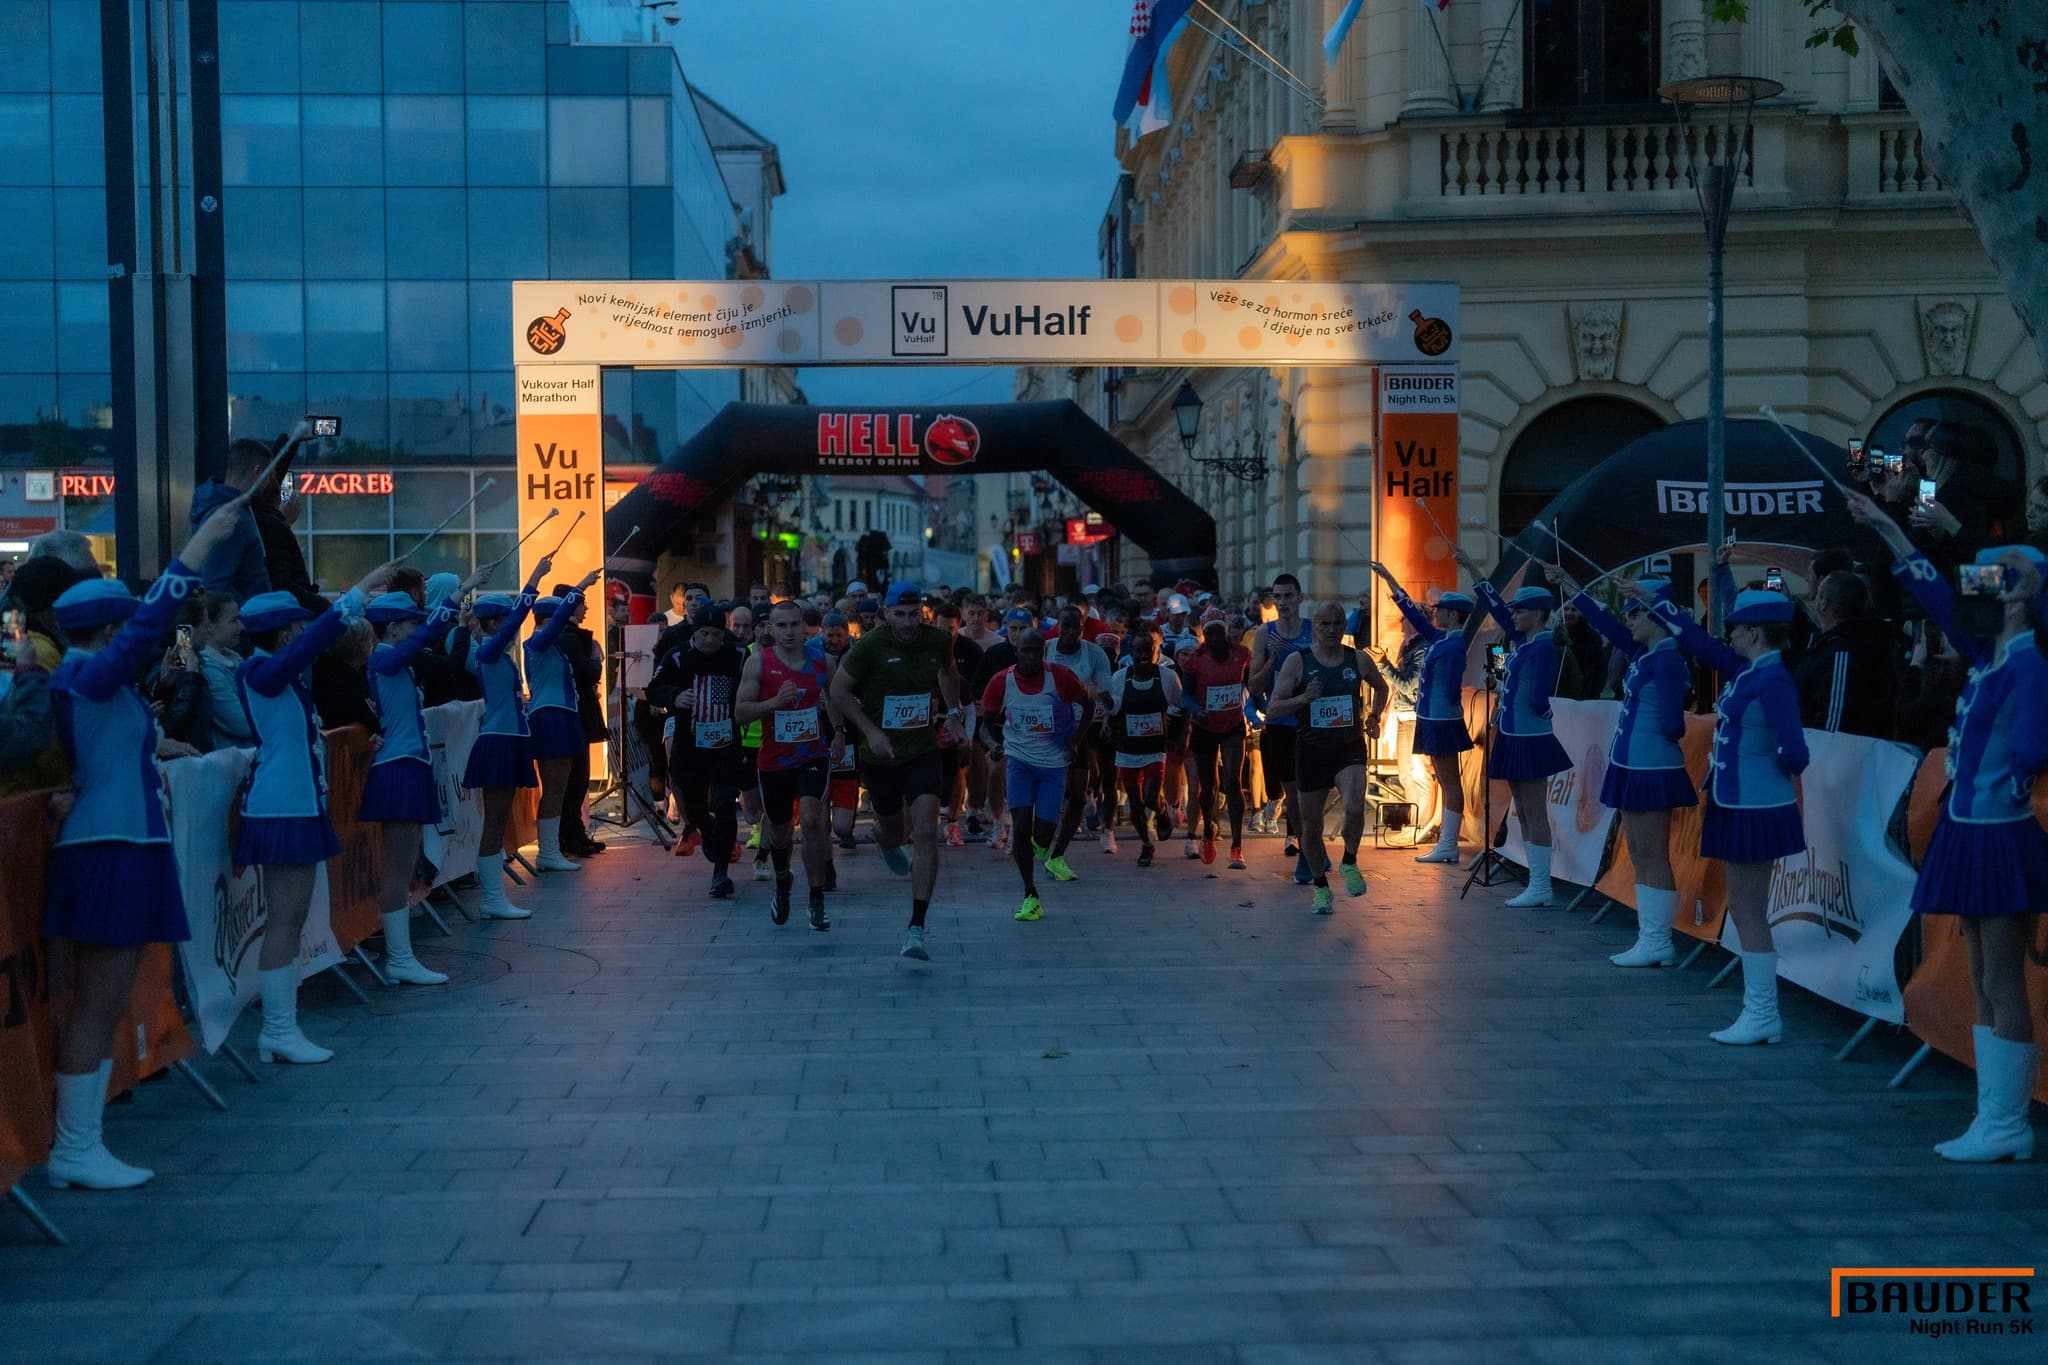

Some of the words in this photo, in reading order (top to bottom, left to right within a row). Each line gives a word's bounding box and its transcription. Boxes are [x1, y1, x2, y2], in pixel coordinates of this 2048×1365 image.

[579, 293, 607, 306] Novi
[609, 294, 661, 318] kemijski
[663, 310, 712, 322] element
[716, 307, 738, 322] čiju
[742, 303, 754, 317] je
[932, 291, 943, 301] 119
[1210, 290, 1238, 304] Veže
[1240, 299, 1254, 309] se
[1256, 304, 1271, 315] za
[1273, 307, 1318, 321] hormon
[1321, 307, 1353, 321] sreće
[612, 313, 674, 335] vrijednost
[677, 323, 737, 339] nemoguće
[740, 304, 797, 331] izmjeriti.
[901, 311, 936, 334] Vu
[962, 305, 1091, 336] VuHalf
[1263, 318, 1269, 329] i
[1270, 321, 1313, 338] djeluje
[1316, 327, 1330, 336] na
[1335, 323, 1354, 335] sve
[1357, 310, 1398, 330] trkače.
[903, 335, 935, 344] VuHalf
[521, 379, 568, 389] Vukovar
[572, 379, 595, 389] Half
[1388, 377, 1454, 391] BAUDER
[522, 393, 577, 402] Marathon
[1388, 394, 1416, 406] Night
[1420, 394, 1441, 404] Run
[1443, 394, 1456, 404] 5k
[818, 413, 920, 456] HELL
[534, 443, 578, 469] Vu
[818, 458, 872, 466] ENERGY
[877, 458, 920, 466] DRINK
[1394, 441, 1437, 467] Vu
[300, 473, 394, 494] ZAGREB
[527, 473, 595, 500] Half
[1387, 471, 1454, 497] Half
[894, 706, 914, 718] 707
[785, 720, 805, 732] 672
